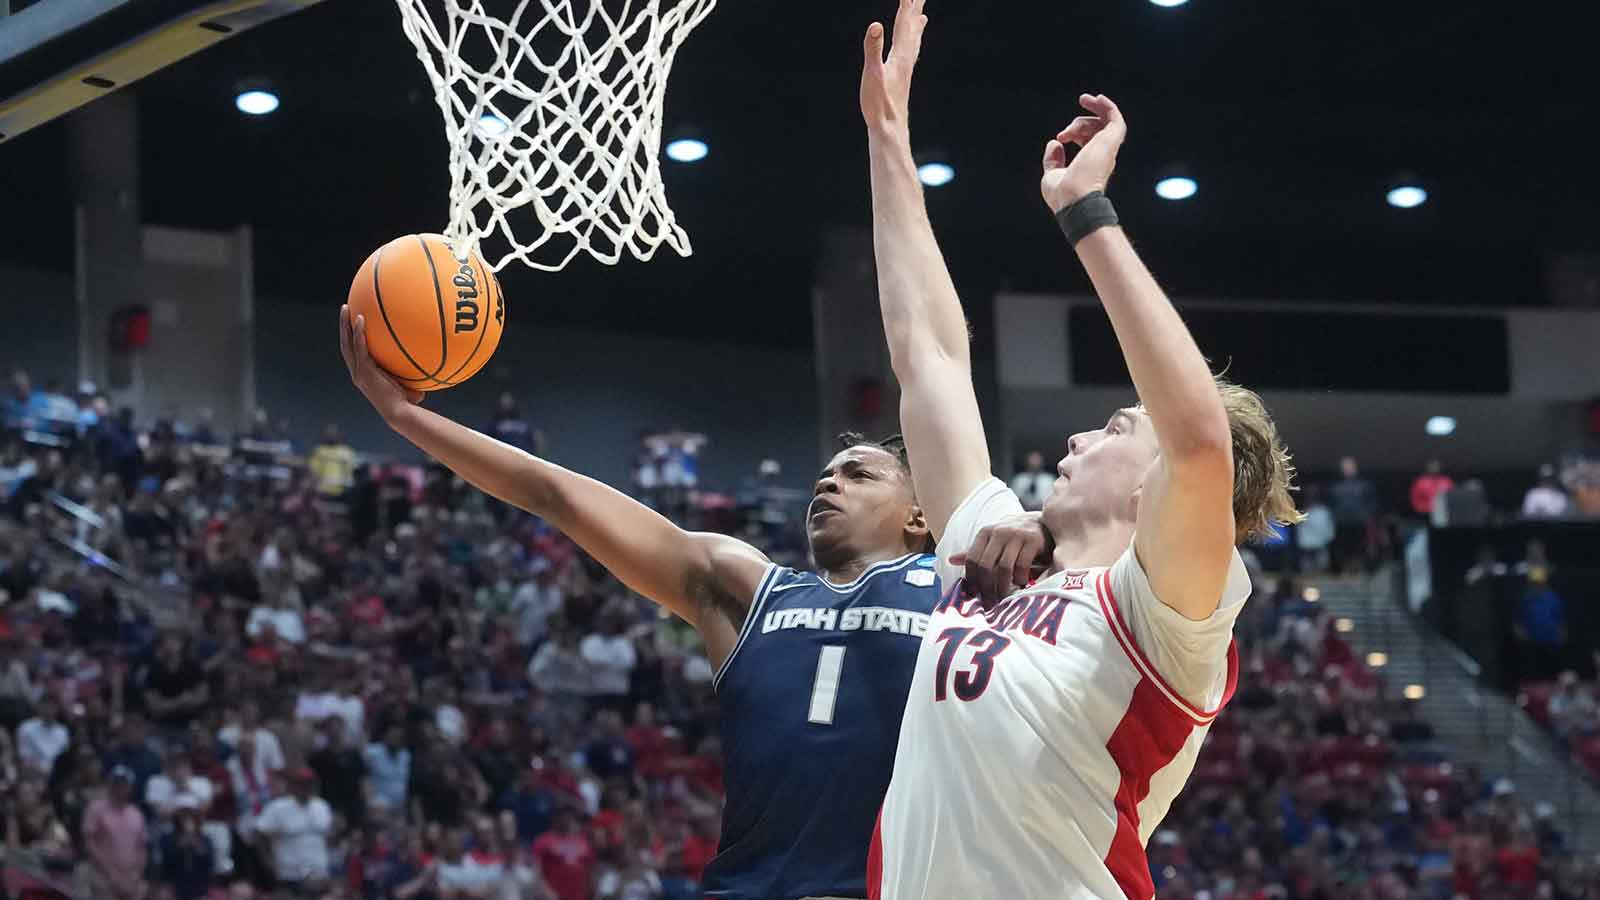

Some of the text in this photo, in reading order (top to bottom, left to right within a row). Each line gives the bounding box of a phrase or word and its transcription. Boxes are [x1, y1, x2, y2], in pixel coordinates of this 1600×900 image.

[453, 257, 479, 334] Wils
[761, 606, 930, 638] UTAH STATE
[808, 645, 846, 725] 1
[935, 627, 1010, 702] 13
